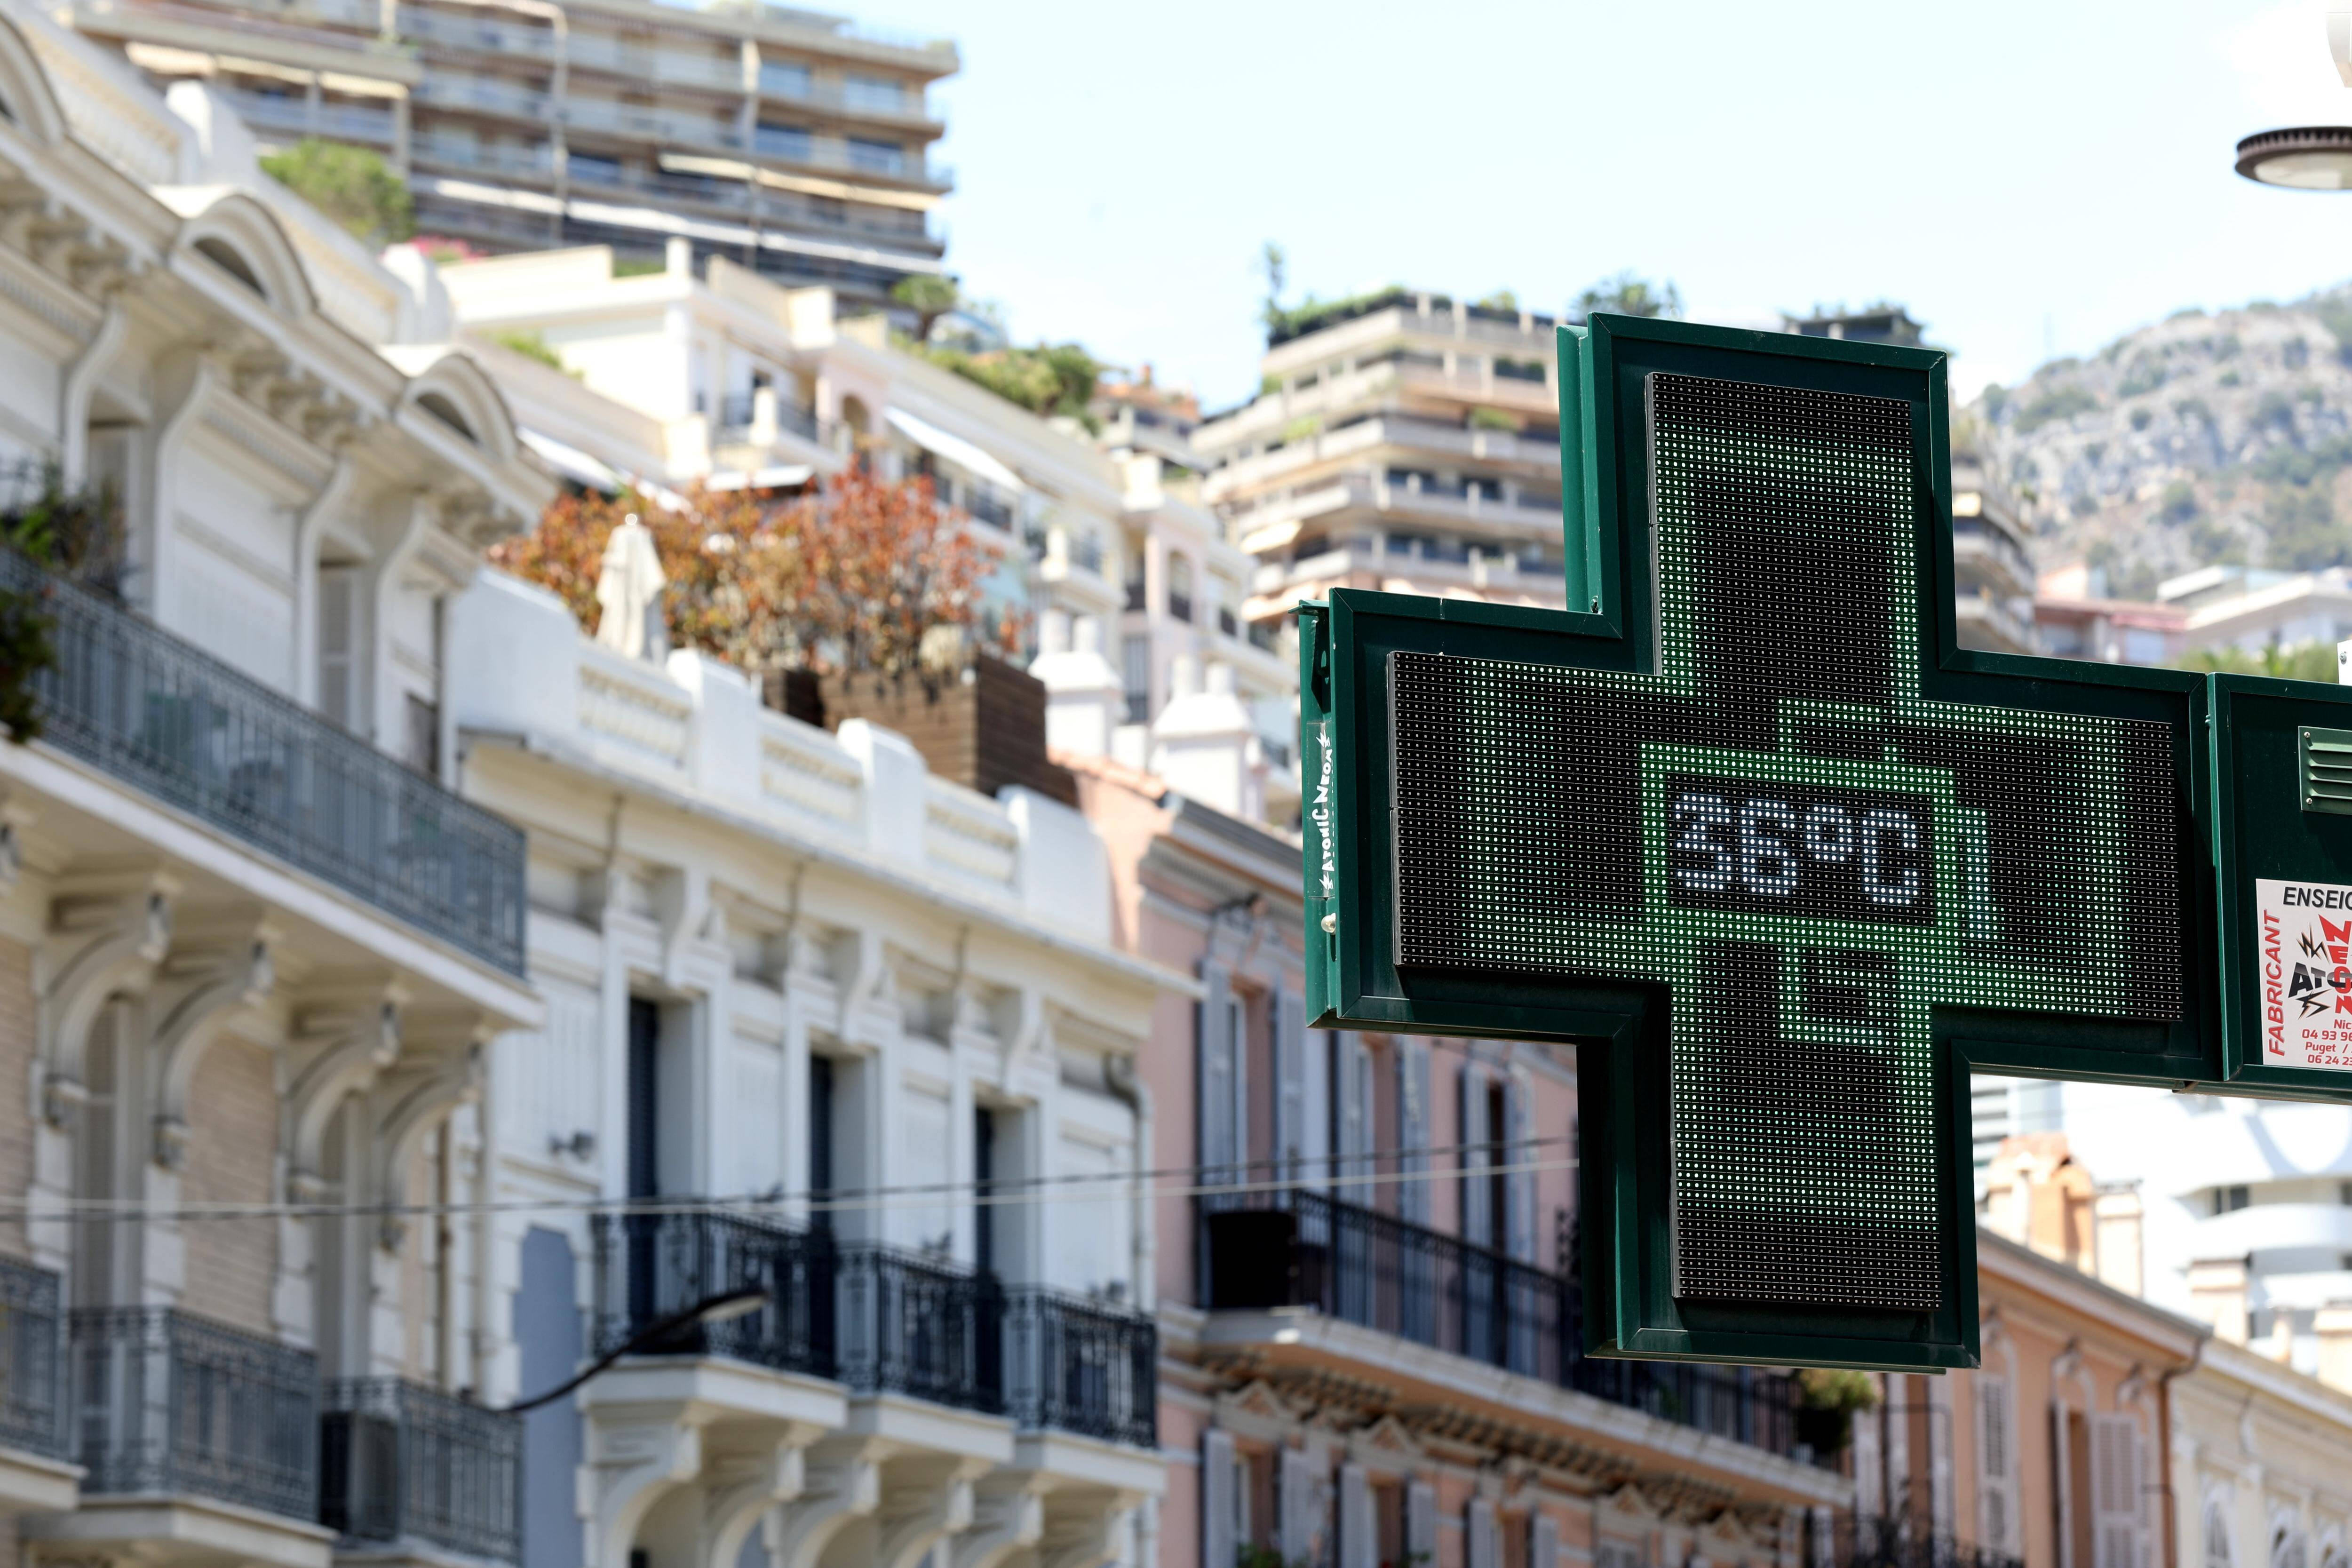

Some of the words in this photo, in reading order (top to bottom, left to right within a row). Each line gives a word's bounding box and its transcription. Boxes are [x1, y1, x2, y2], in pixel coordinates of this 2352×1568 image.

[2264, 908, 2285, 1057] FABRICANT
[2334, 1019, 2352, 1030] Nic
[2302, 1029, 2318, 1039] 04
[2321, 1030, 2337, 1041] 93
[2305, 1042, 2336, 1054] Puget
[2307, 1054, 2322, 1064] 06
[2325, 1055, 2339, 1065] 24
